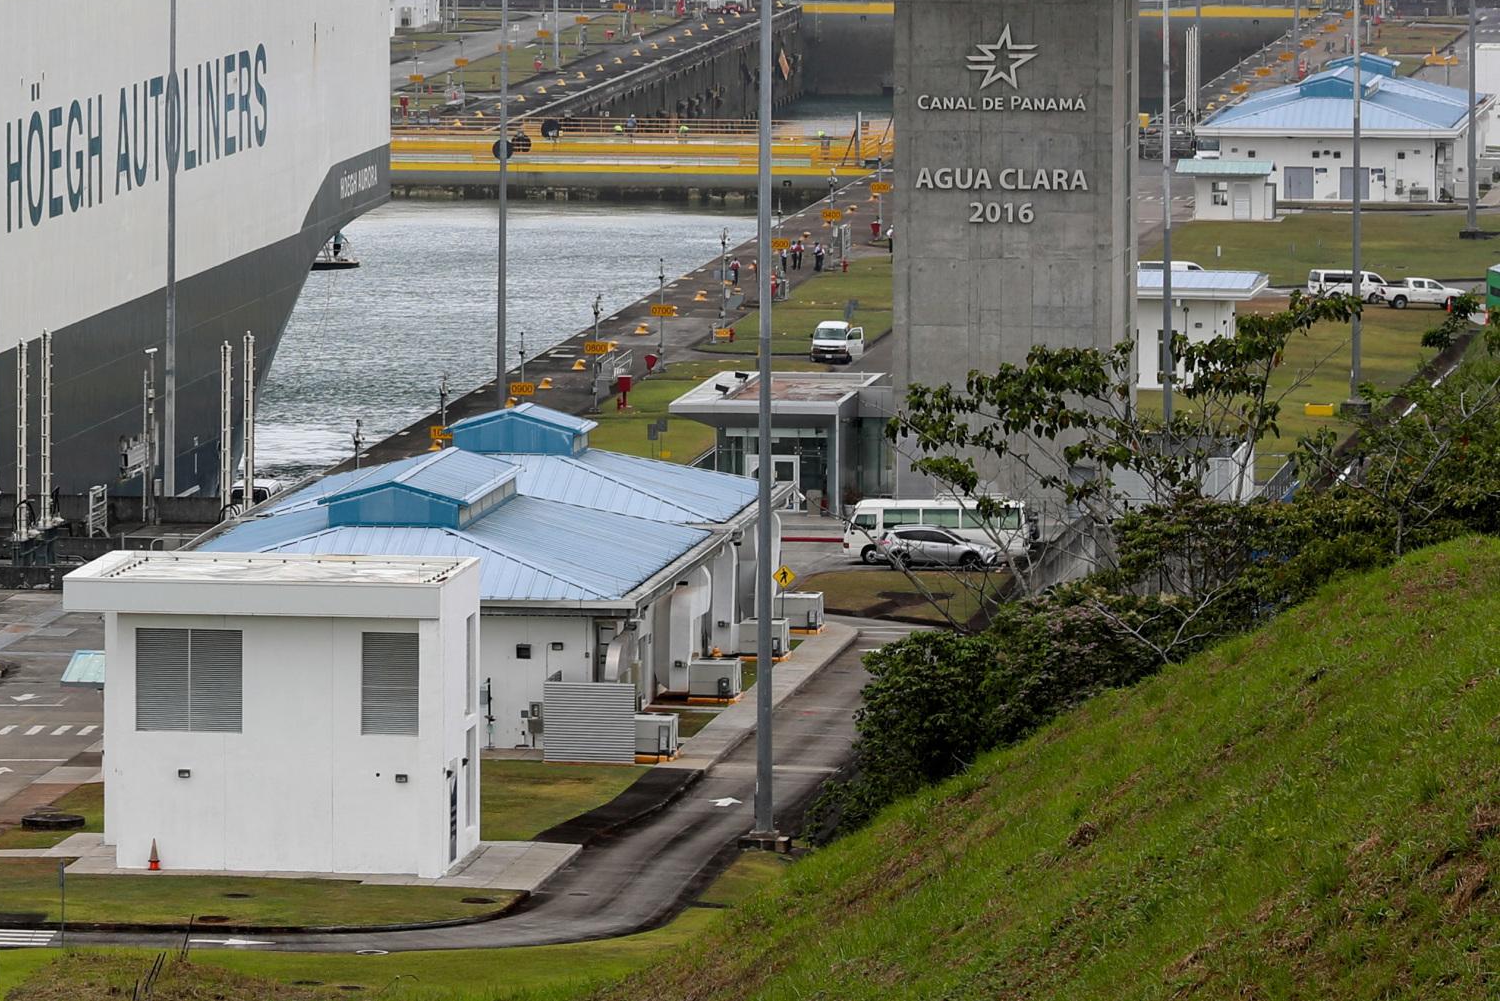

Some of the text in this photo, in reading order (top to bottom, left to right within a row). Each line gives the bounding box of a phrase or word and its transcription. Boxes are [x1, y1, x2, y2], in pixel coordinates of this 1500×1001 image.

[917, 95, 977, 111] CANAL
[982, 97, 1004, 111] DE
[6, 43, 268, 234] HÖEGH AUTOLINERS
[915, 167, 1089, 191] AGUA CLARA
[969, 202, 1035, 223] 2016
